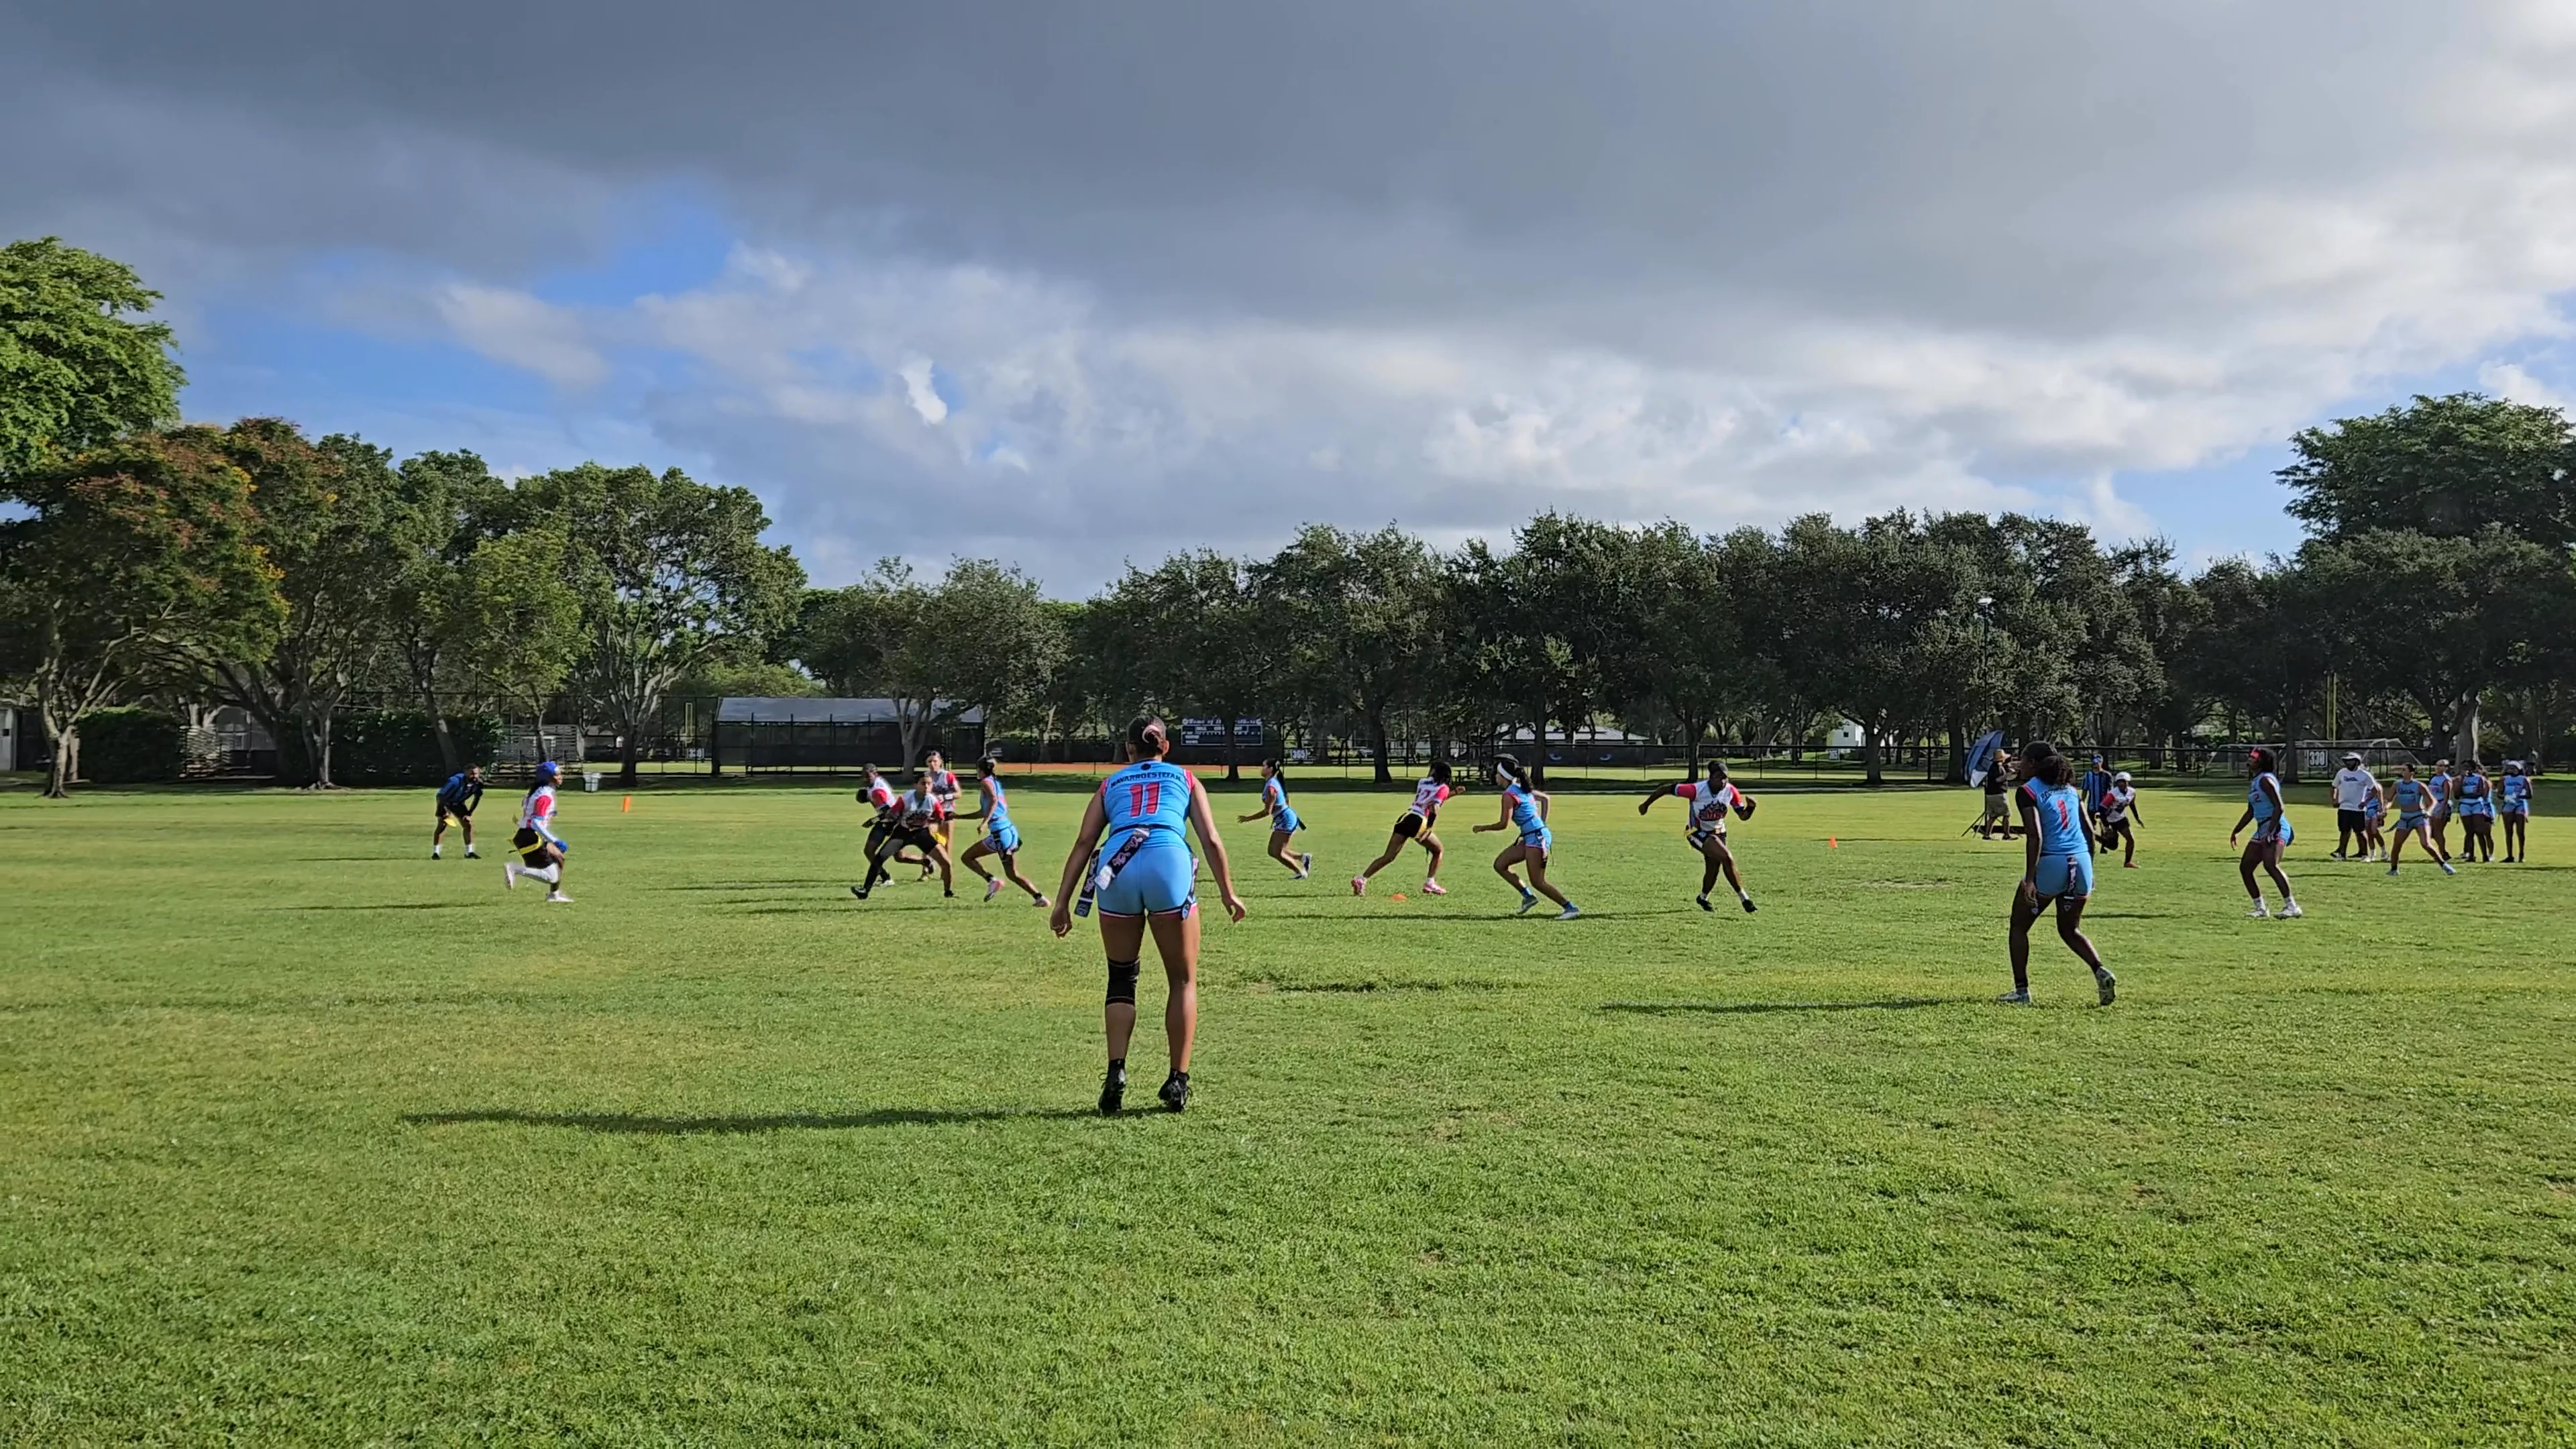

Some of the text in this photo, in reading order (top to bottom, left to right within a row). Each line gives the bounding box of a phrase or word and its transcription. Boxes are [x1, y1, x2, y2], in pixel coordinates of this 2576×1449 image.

[2309, 751, 2325, 765] 330
[1129, 780, 1161, 818] 11
[2057, 798, 2069, 830] 1
